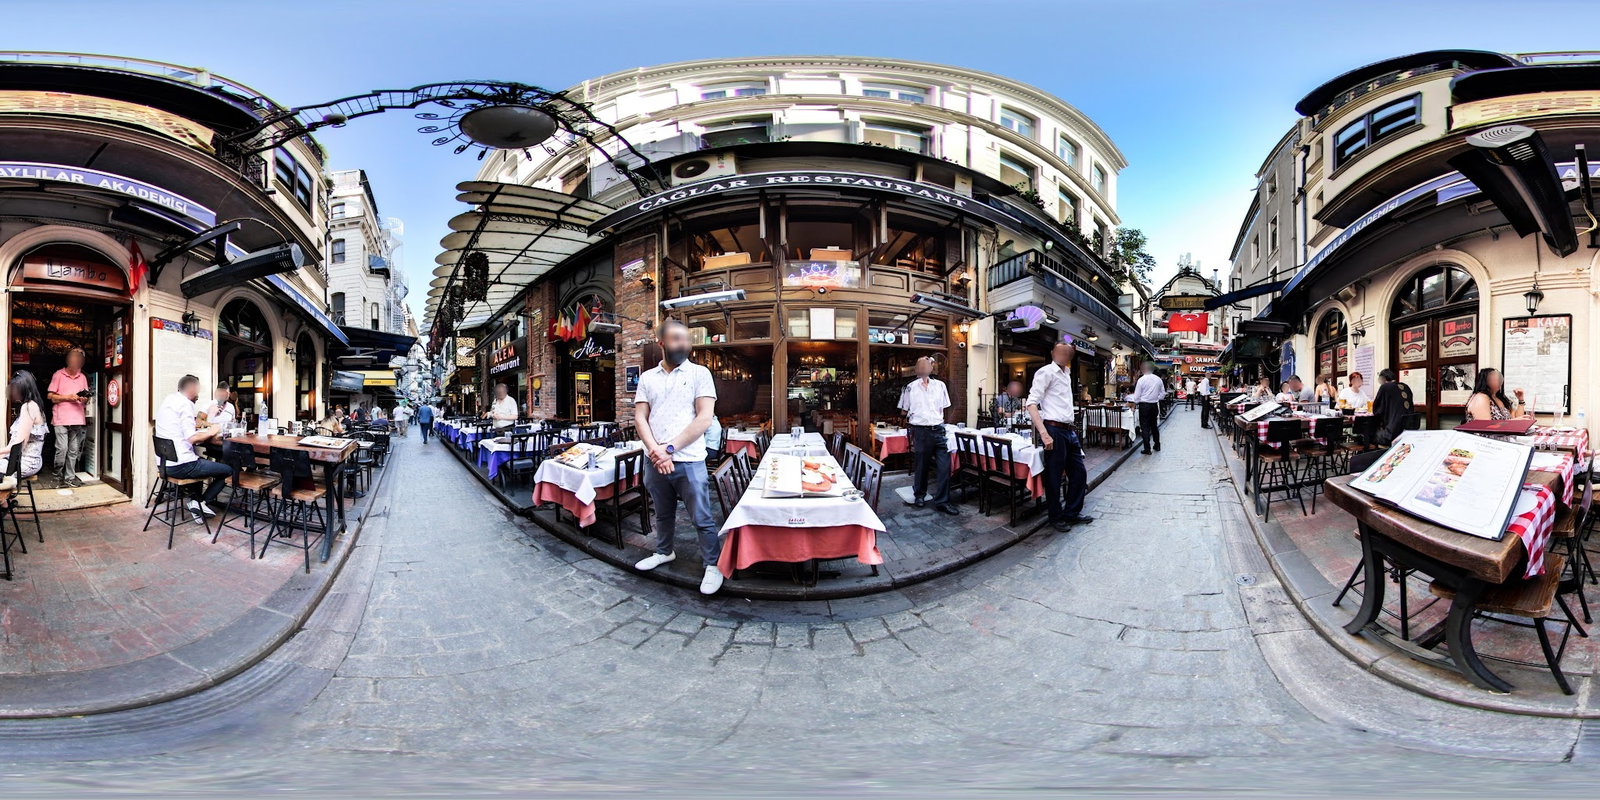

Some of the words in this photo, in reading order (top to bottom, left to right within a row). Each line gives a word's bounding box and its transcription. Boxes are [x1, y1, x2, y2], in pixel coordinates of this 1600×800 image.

[765, 175, 967, 208] RESTAURANT
[47, 260, 107, 282] Lambo
[1445, 321, 1472, 335] Lambo
[1538, 317, 1567, 327] KAFA
[1404, 330, 1424, 343] Lambo
[494, 345, 515, 363] ALEM
[490, 357, 520, 374] restaurant
